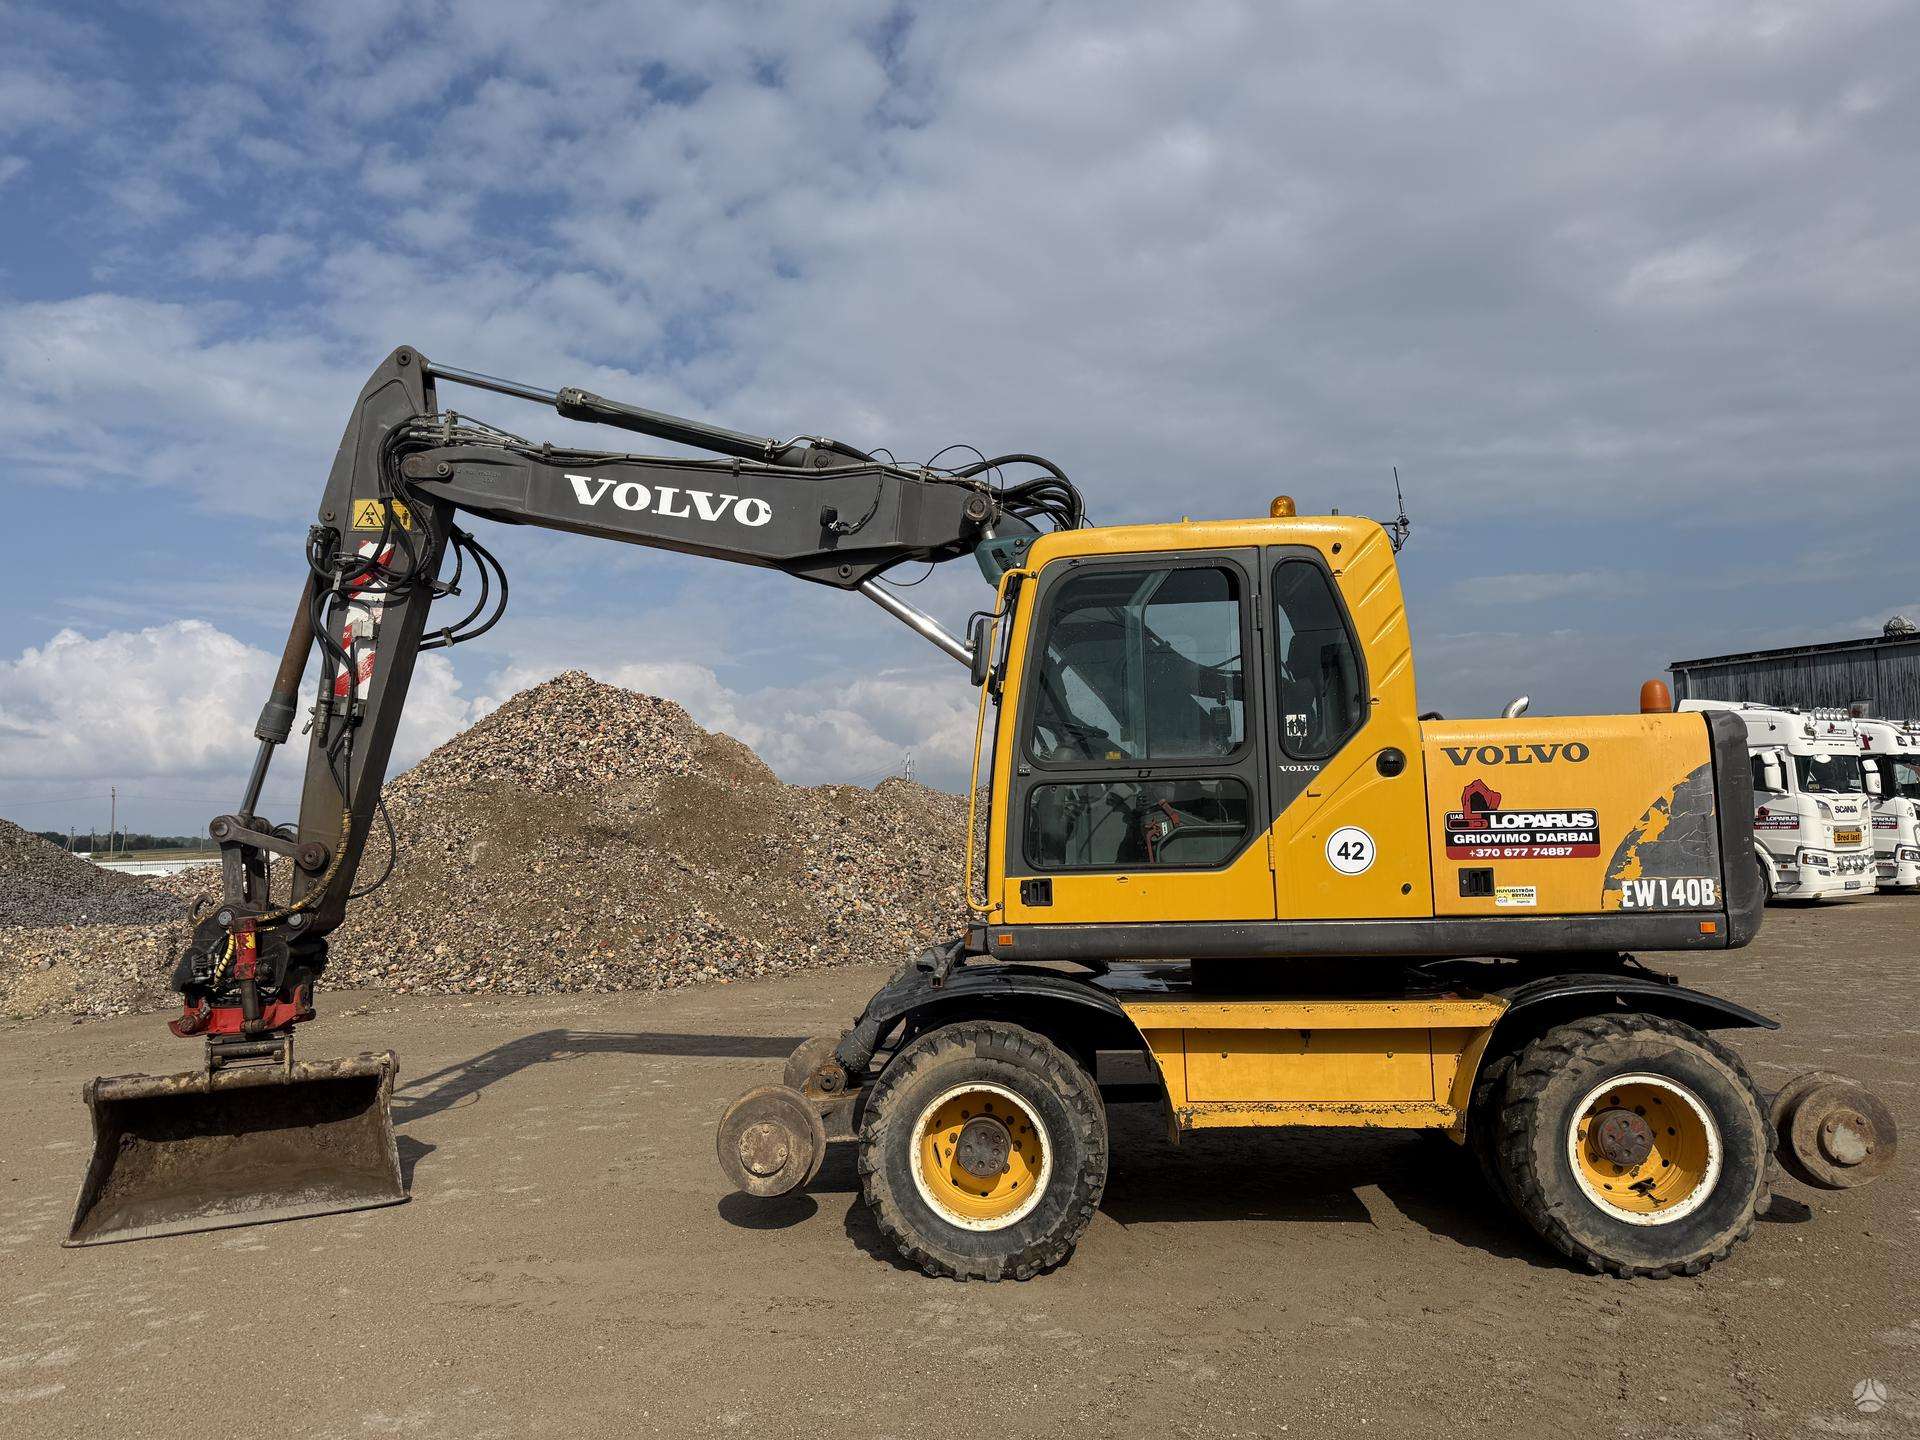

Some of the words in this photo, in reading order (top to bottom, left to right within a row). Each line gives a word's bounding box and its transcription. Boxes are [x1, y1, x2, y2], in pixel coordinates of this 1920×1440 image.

[564, 474, 772, 527] VOLVO
[1441, 742, 1590, 766] VOLVO
[1835, 805, 1858, 813] SCANIA
[1490, 812, 1595, 829] LOPARUS
[1453, 833, 1531, 844] GRIOVIMO
[1535, 832, 1593, 843] DARBAI
[1337, 841, 1365, 860] 42
[1469, 848, 1500, 857] +370
[1504, 848, 1527, 857] 677
[1532, 847, 1573, 856] 74887
[1621, 878, 1716, 907] EW140B
